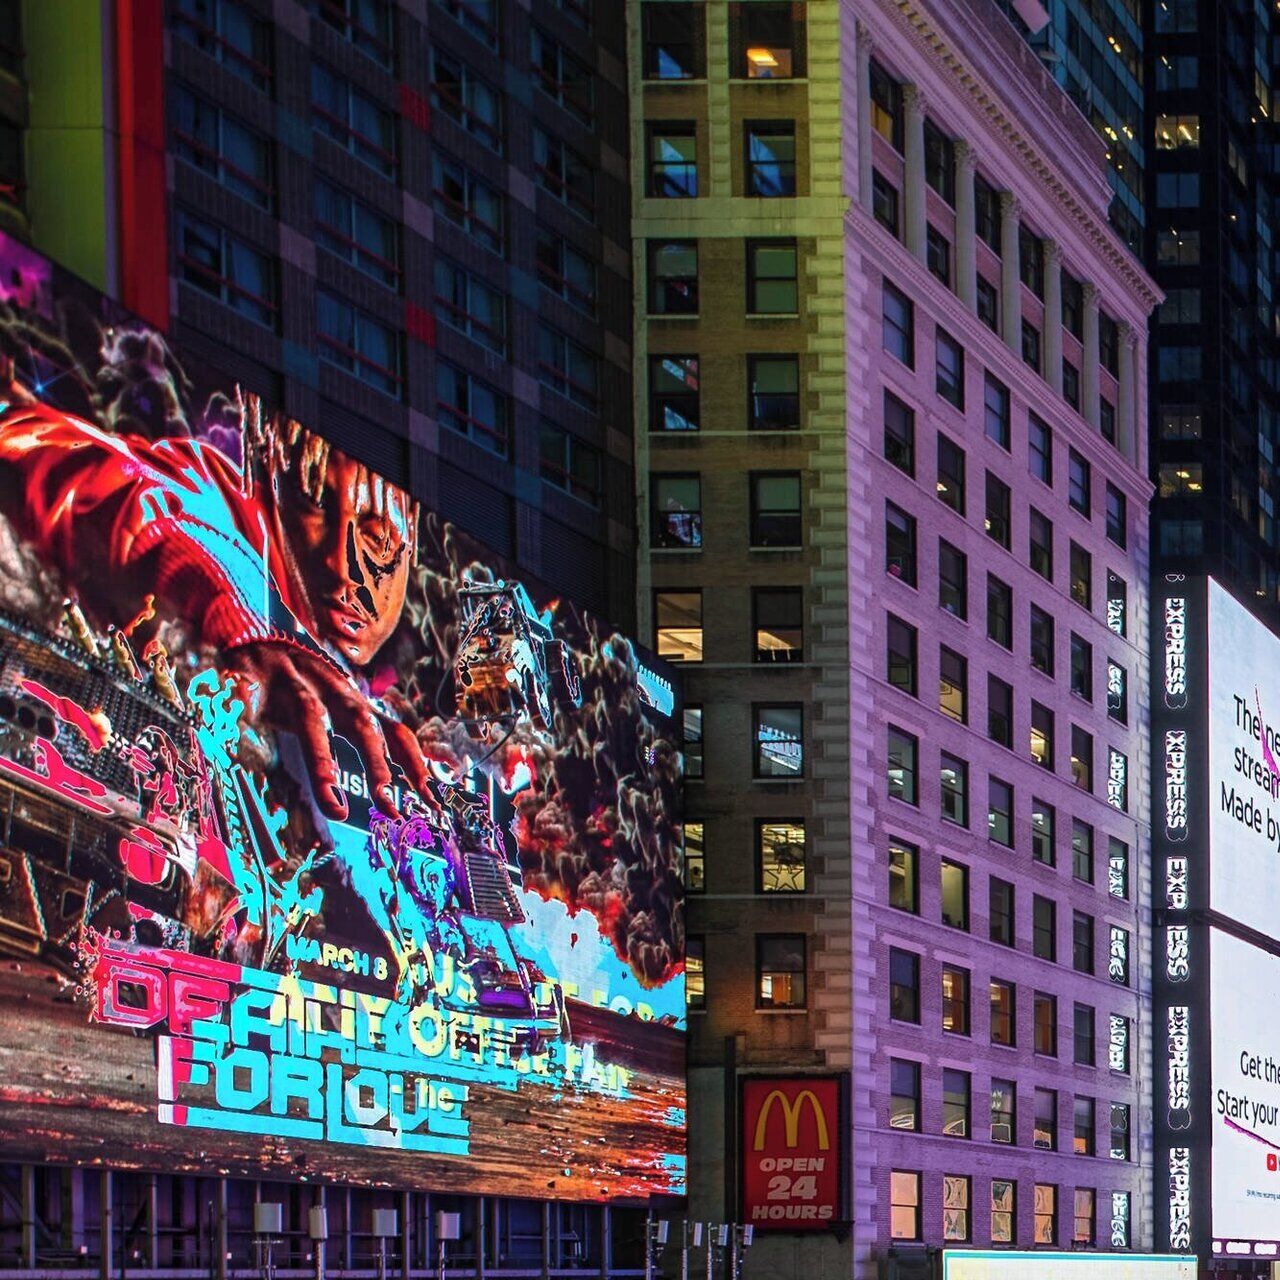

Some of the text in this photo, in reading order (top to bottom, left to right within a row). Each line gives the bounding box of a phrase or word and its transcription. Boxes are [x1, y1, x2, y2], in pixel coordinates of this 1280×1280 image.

[1233, 694, 1261, 741] The
[286, 934, 388, 980] MARCH 8
[1217, 1089, 1249, 1121] Start
[1252, 1100, 1279, 1129] your
[758, 1157, 825, 1174] OPEN
[766, 1175, 818, 1201] 24
[751, 1203, 834, 1221] HOURS
